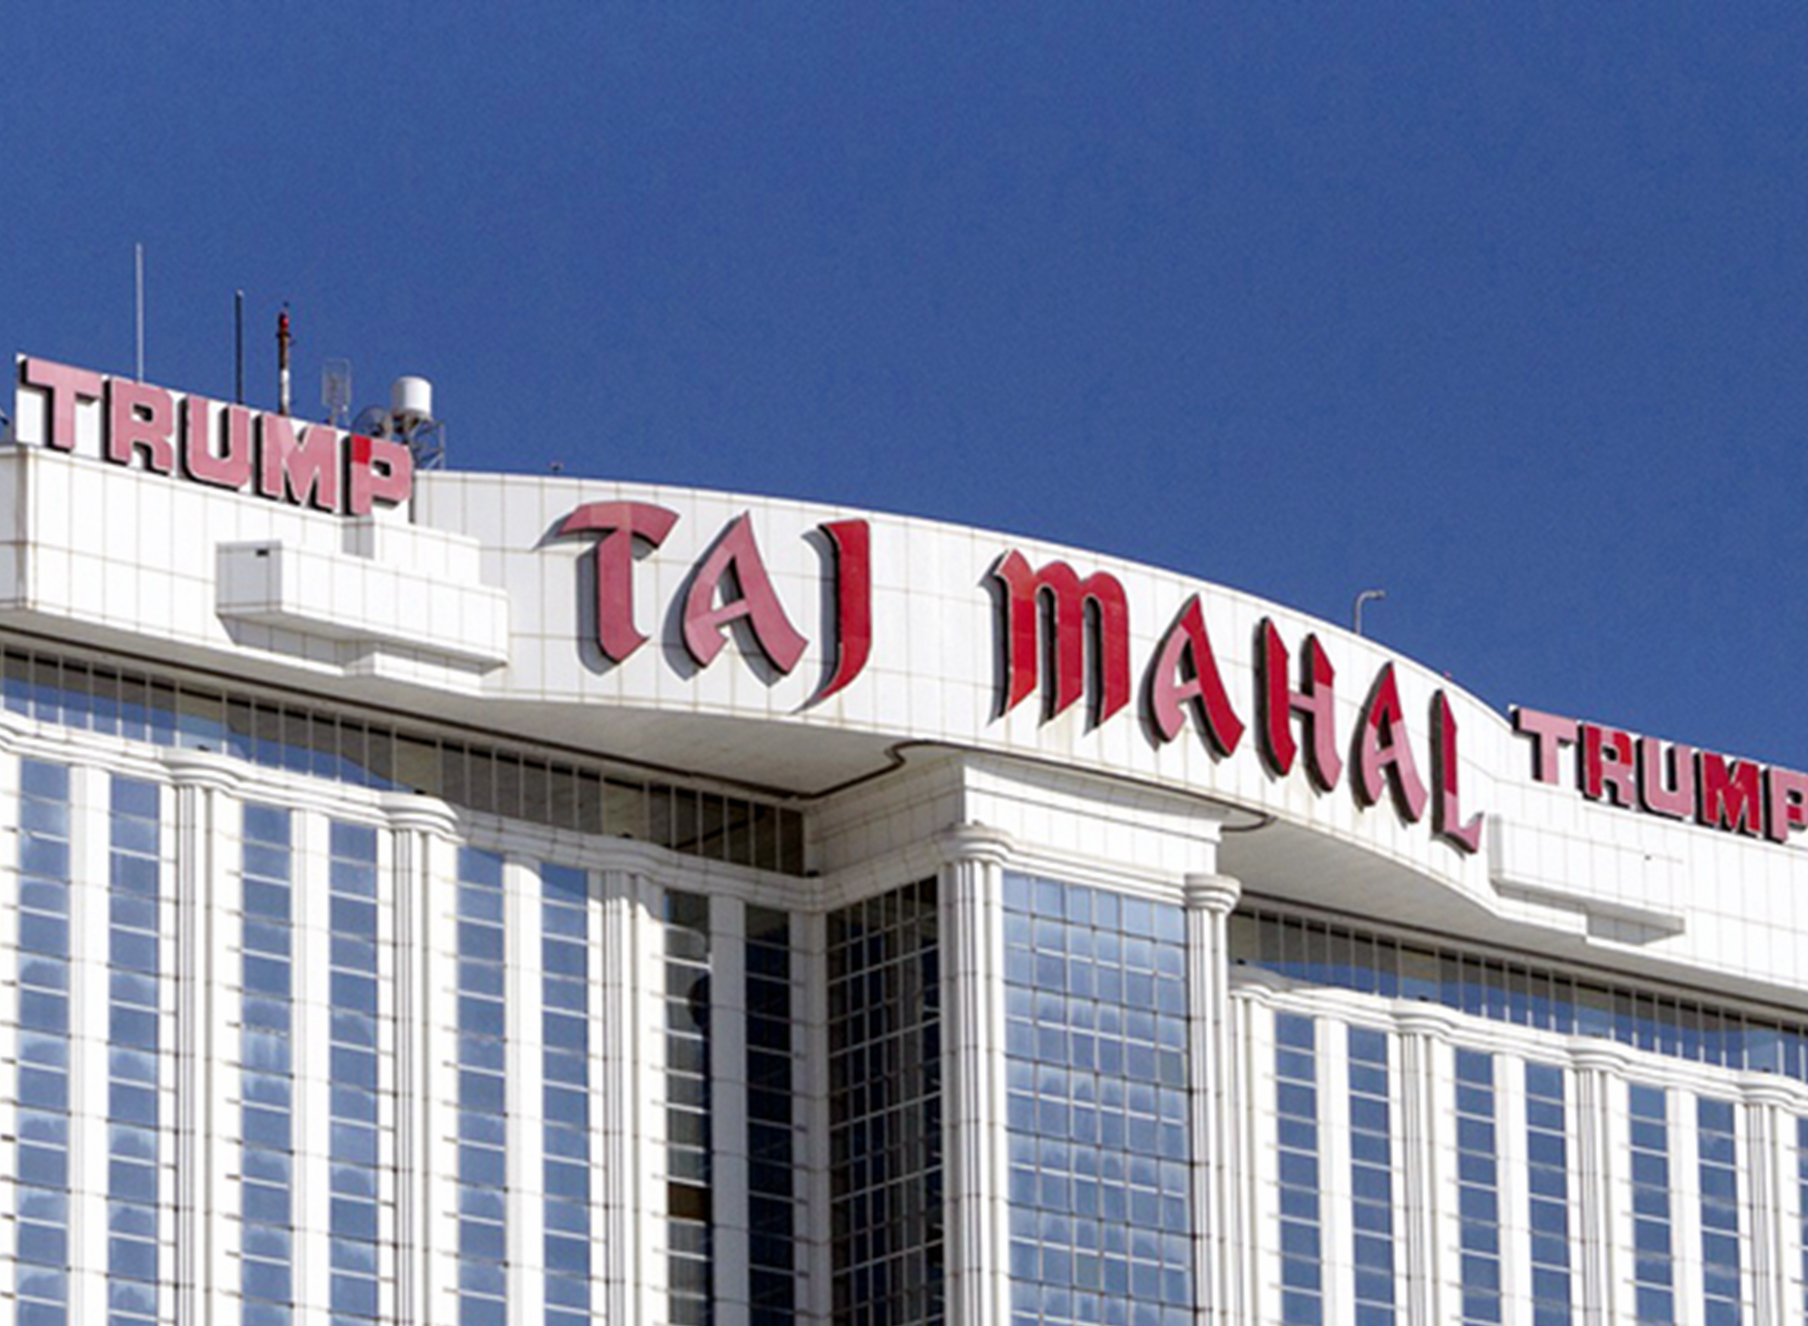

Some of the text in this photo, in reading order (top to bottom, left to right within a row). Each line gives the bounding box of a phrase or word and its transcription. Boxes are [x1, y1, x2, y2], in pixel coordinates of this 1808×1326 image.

[18, 356, 412, 516] TRUMP
[545, 500, 1483, 854] TAJ MAHAL
